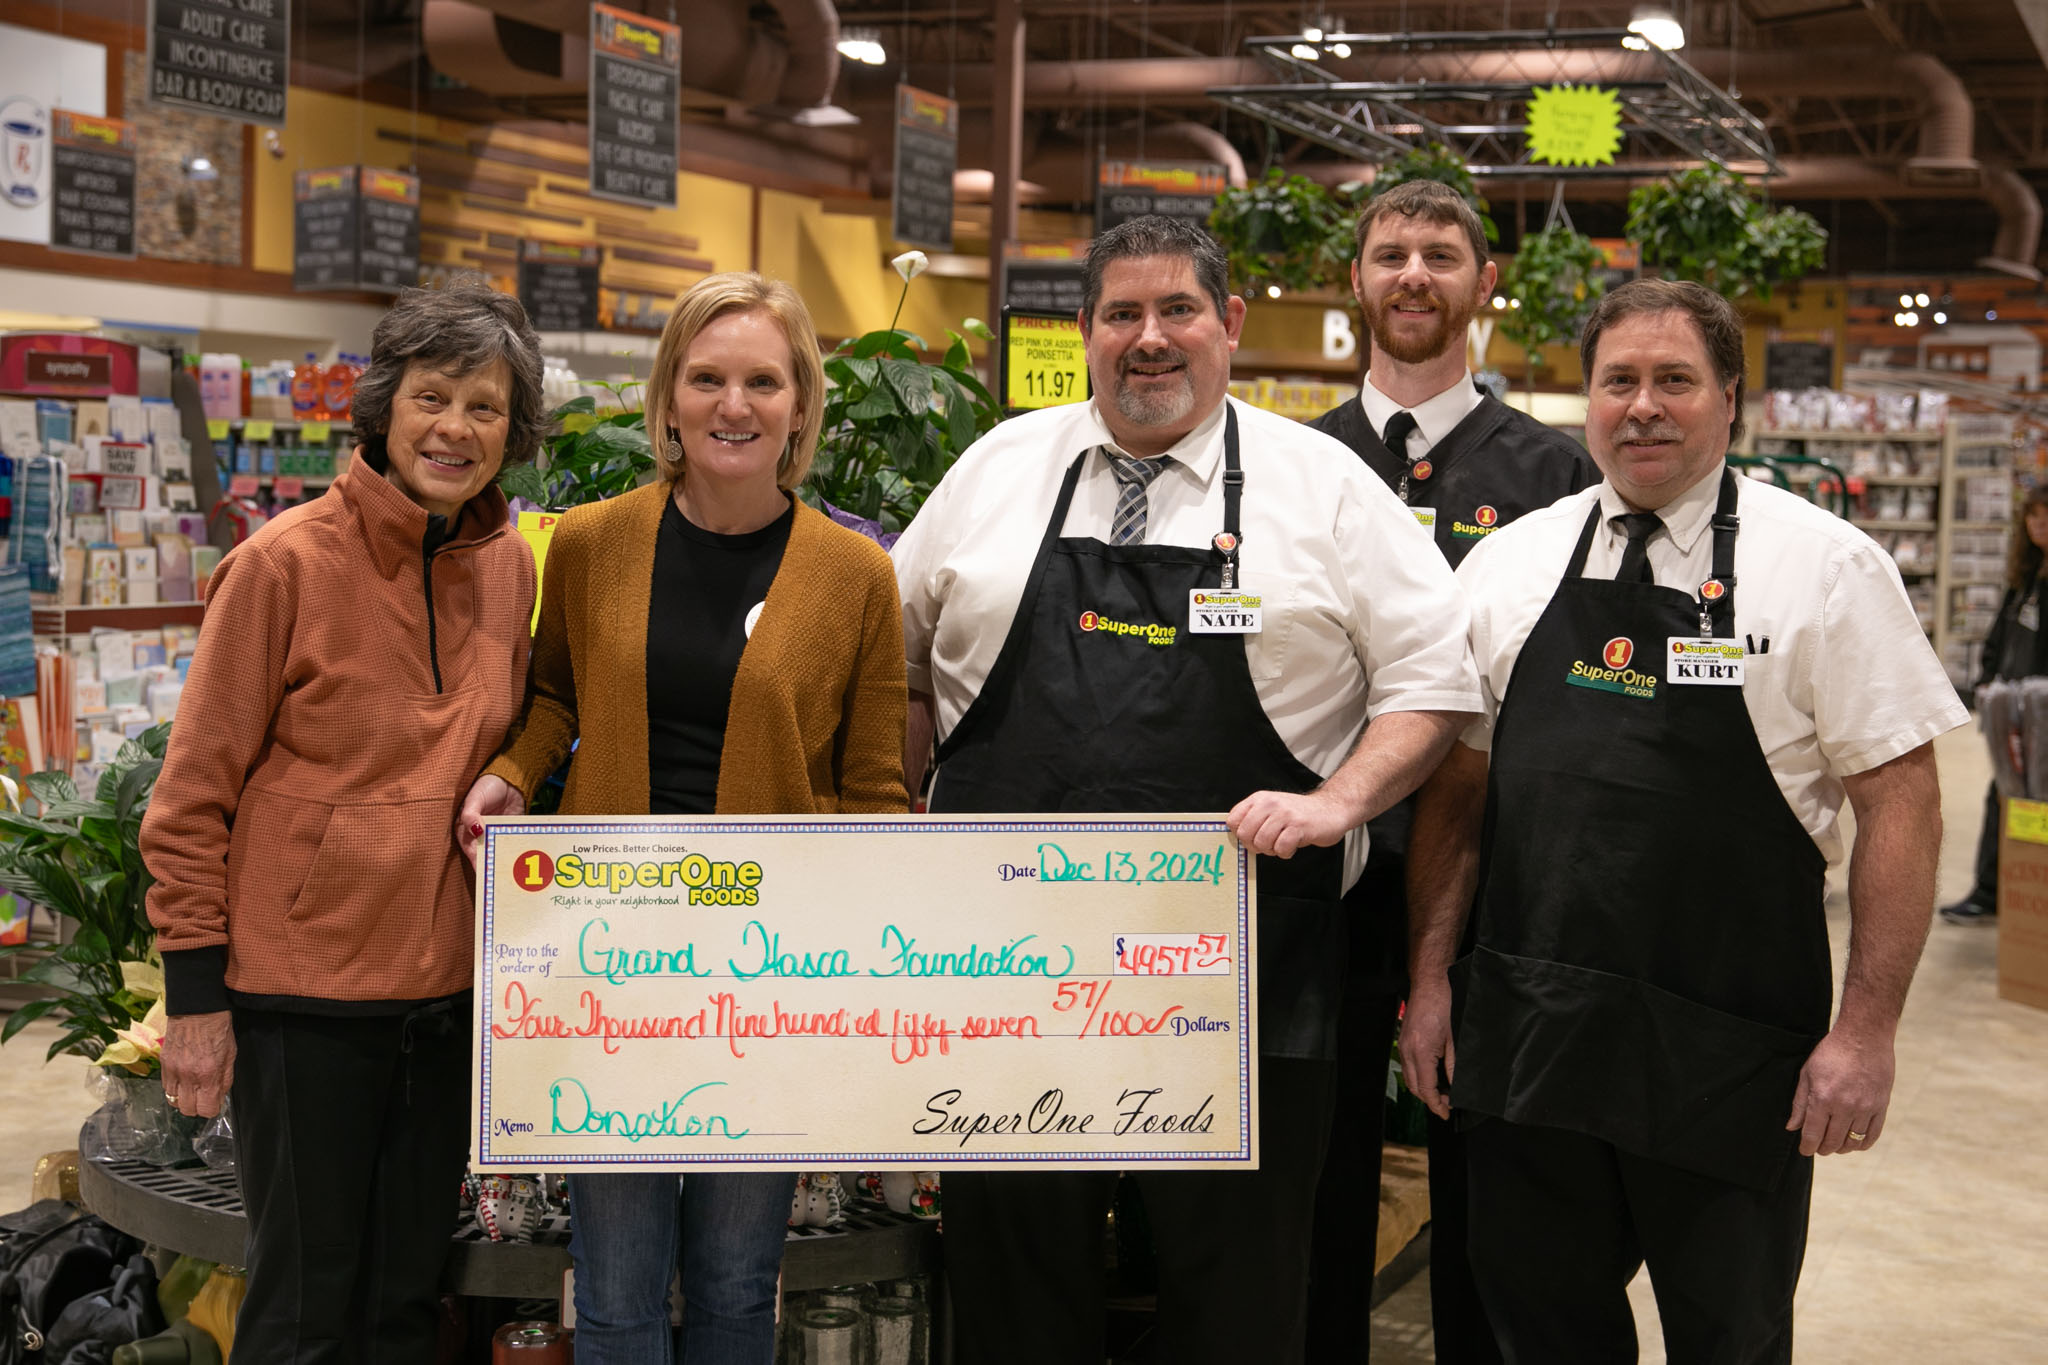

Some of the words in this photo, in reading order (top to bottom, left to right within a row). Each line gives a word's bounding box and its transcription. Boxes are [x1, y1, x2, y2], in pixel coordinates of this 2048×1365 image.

[181, 8, 225, 38] ADULT
[229, 20, 265, 48] CARE
[170, 40, 274, 83] INCONTINENCE
[156, 69, 184, 97] BAR
[187, 78, 197, 99] &
[200, 78, 243, 107] BODY
[245, 87, 283, 116] SOAP
[1017, 316, 1054, 330] PRICE
[1059, 319, 1077, 331] CU
[1010, 336, 1024, 347] RED
[1026, 337, 1041, 348] PINK
[1043, 338, 1053, 348] OR
[1055, 339, 1085, 350] ASSORTE
[1026, 348, 1074, 361] POINSETTIA
[46, 361, 90, 377] sympathy
[1025, 368, 1076, 398] 11.97
[107, 448, 136, 462] SAVE
[108, 462, 136, 475] NOW
[1205, 594, 1262, 605] SuperOne
[1097, 616, 1177, 637] SuperOne
[1200, 614, 1254, 627] NATE
[1147, 636, 1175, 645] FOODS
[1684, 644, 1744, 655] SuperOne
[1571, 660, 1657, 688] SuperOne
[1677, 664, 1738, 679] KURT
[1624, 686, 1654, 697] FOODS
[573, 845, 590, 853] Low
[593, 845, 621, 853] Prices.
[623, 845, 649, 853] Better
[652, 845, 688, 853] Choices.
[1037, 843, 1096, 882] Dec
[555, 853, 763, 894] SuperOne
[998, 864, 1037, 882] Date
[551, 895, 582, 909] Right
[584, 895, 593, 905] in
[595, 896, 618, 909] your
[620, 895, 680, 907] neighborhood
[688, 886, 759, 906] FOODS
[495, 944, 523, 963] Pay
[526, 946, 537, 957] to
[541, 944, 558, 957] the
[579, 917, 712, 985] Grand
[868, 924, 1075, 978] Foundation
[500, 959, 534, 973] order
[539, 962, 552, 977] of
[491, 981, 573, 1040] Four
[574, 990, 706, 1056] Thousand
[892, 1008, 957, 1064] fifty
[961, 1014, 1043, 1041] seven
[1170, 1016, 1231, 1037] Dollars
[550, 1077, 749, 1142] Donation
[912, 1088, 1095, 1148] SuperOne
[1113, 1088, 1214, 1137] Foods
[494, 1119, 534, 1137] Memo
